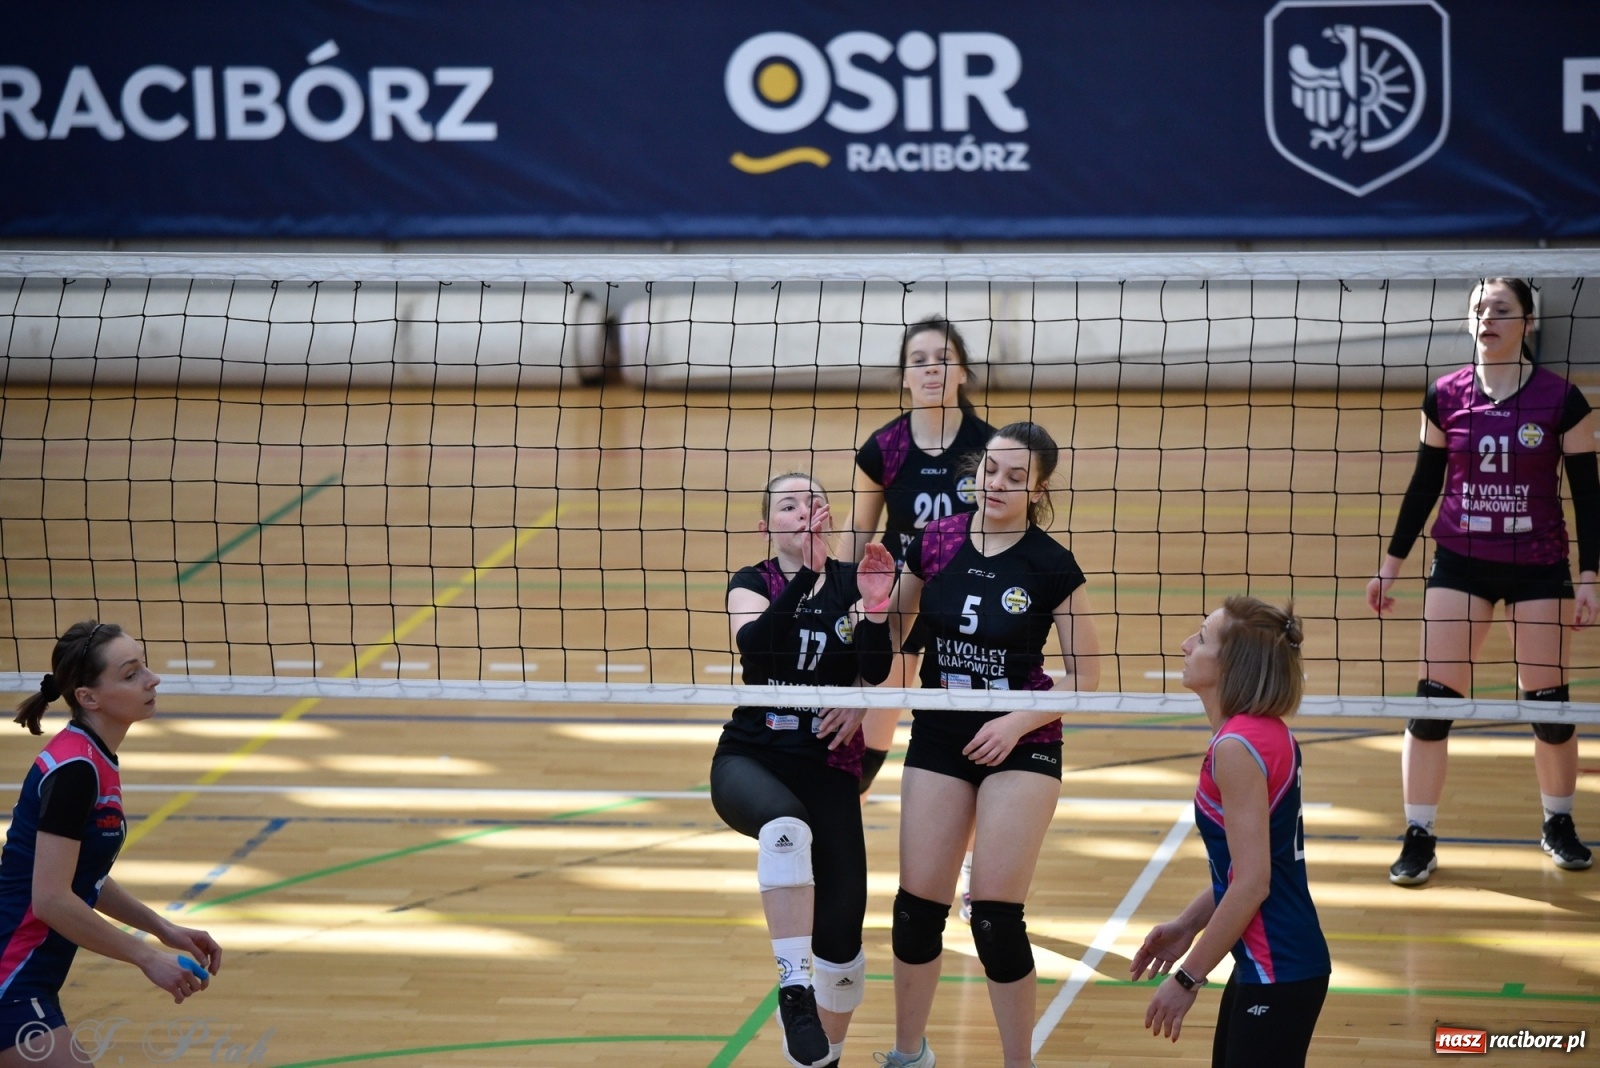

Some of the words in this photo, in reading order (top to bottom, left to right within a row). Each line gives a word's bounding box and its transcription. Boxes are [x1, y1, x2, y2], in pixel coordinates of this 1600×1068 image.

[0, 39, 497, 141] RACIBÓRZ
[846, 135, 1030, 172] RACIBÓRZ
[1478, 435, 1509, 473] 21
[913, 492, 952, 529] 20
[1461, 498, 1528, 513] KRAPKOWICE
[1478, 484, 1530, 501] VOLLEY
[958, 594, 982, 635] 5
[796, 629, 827, 671] 17
[954, 640, 1007, 665] VOLLEY
[1031, 753, 1057, 764] COLO
[1246, 1005, 1270, 1015] 4F
